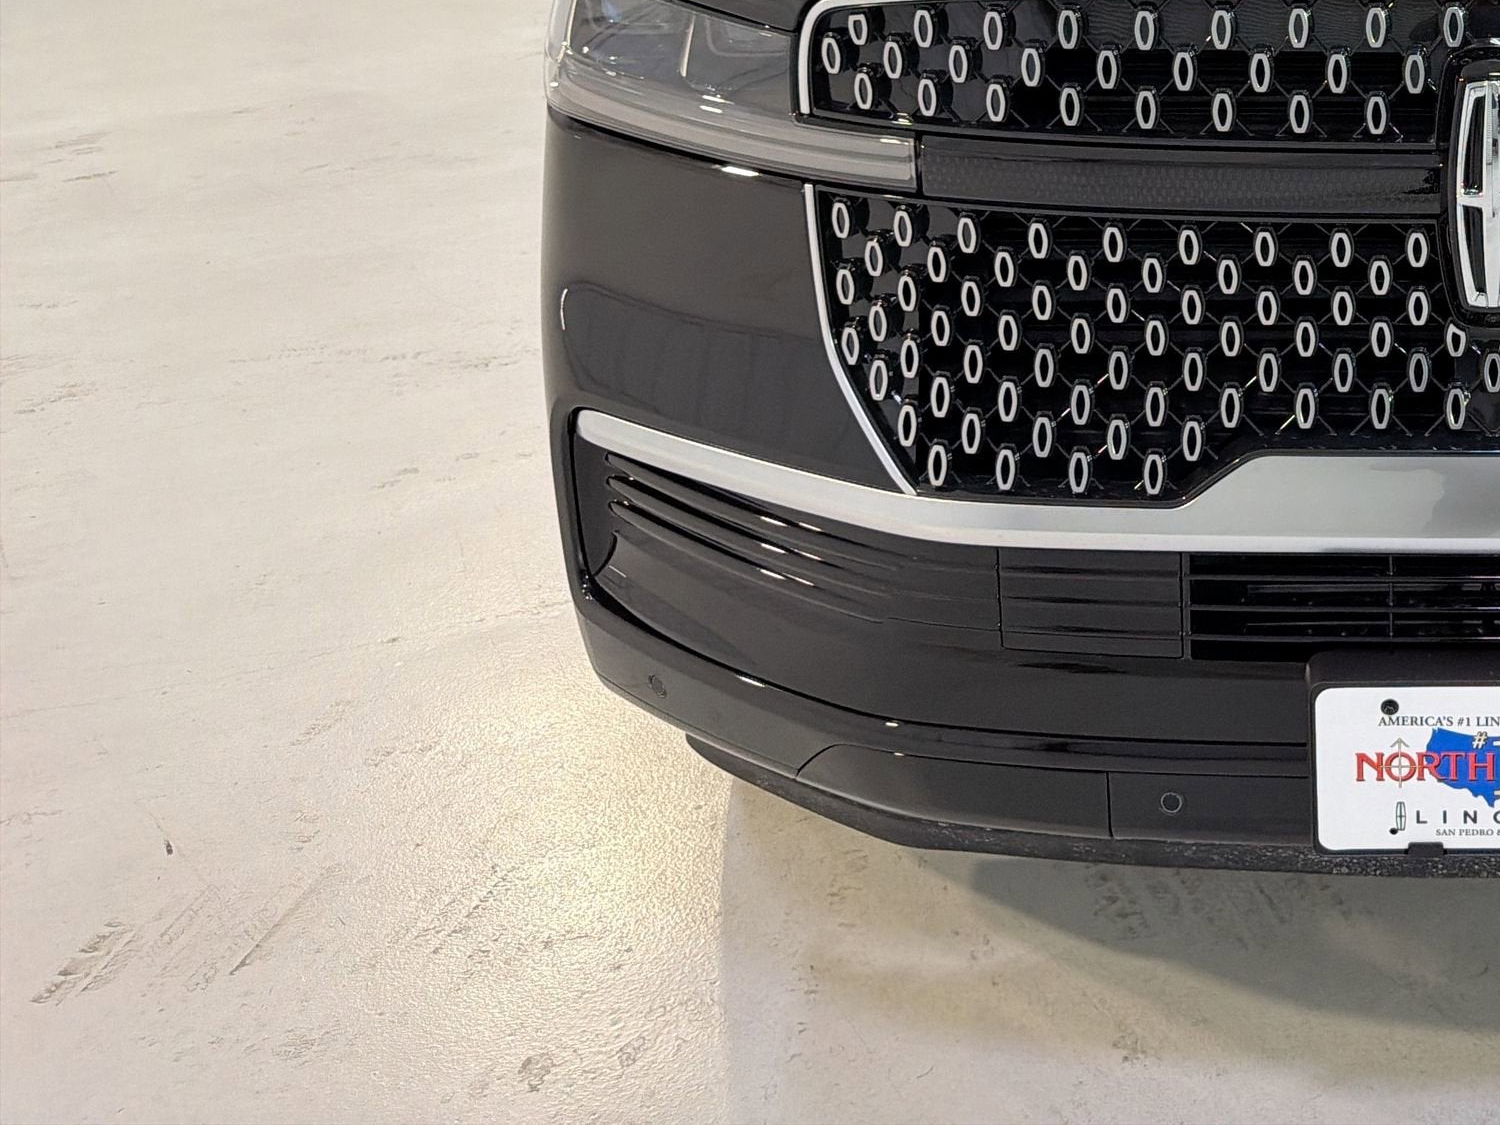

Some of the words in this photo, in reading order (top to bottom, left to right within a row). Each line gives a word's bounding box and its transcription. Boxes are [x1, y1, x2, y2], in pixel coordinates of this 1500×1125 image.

[1378, 715, 1453, 727] AMERICA'S
[1457, 715, 1472, 727] #1
[1355, 751, 1496, 783] NORTH
[1435, 828, 1457, 837] SAN
[1458, 828, 1494, 837] PEDRO
